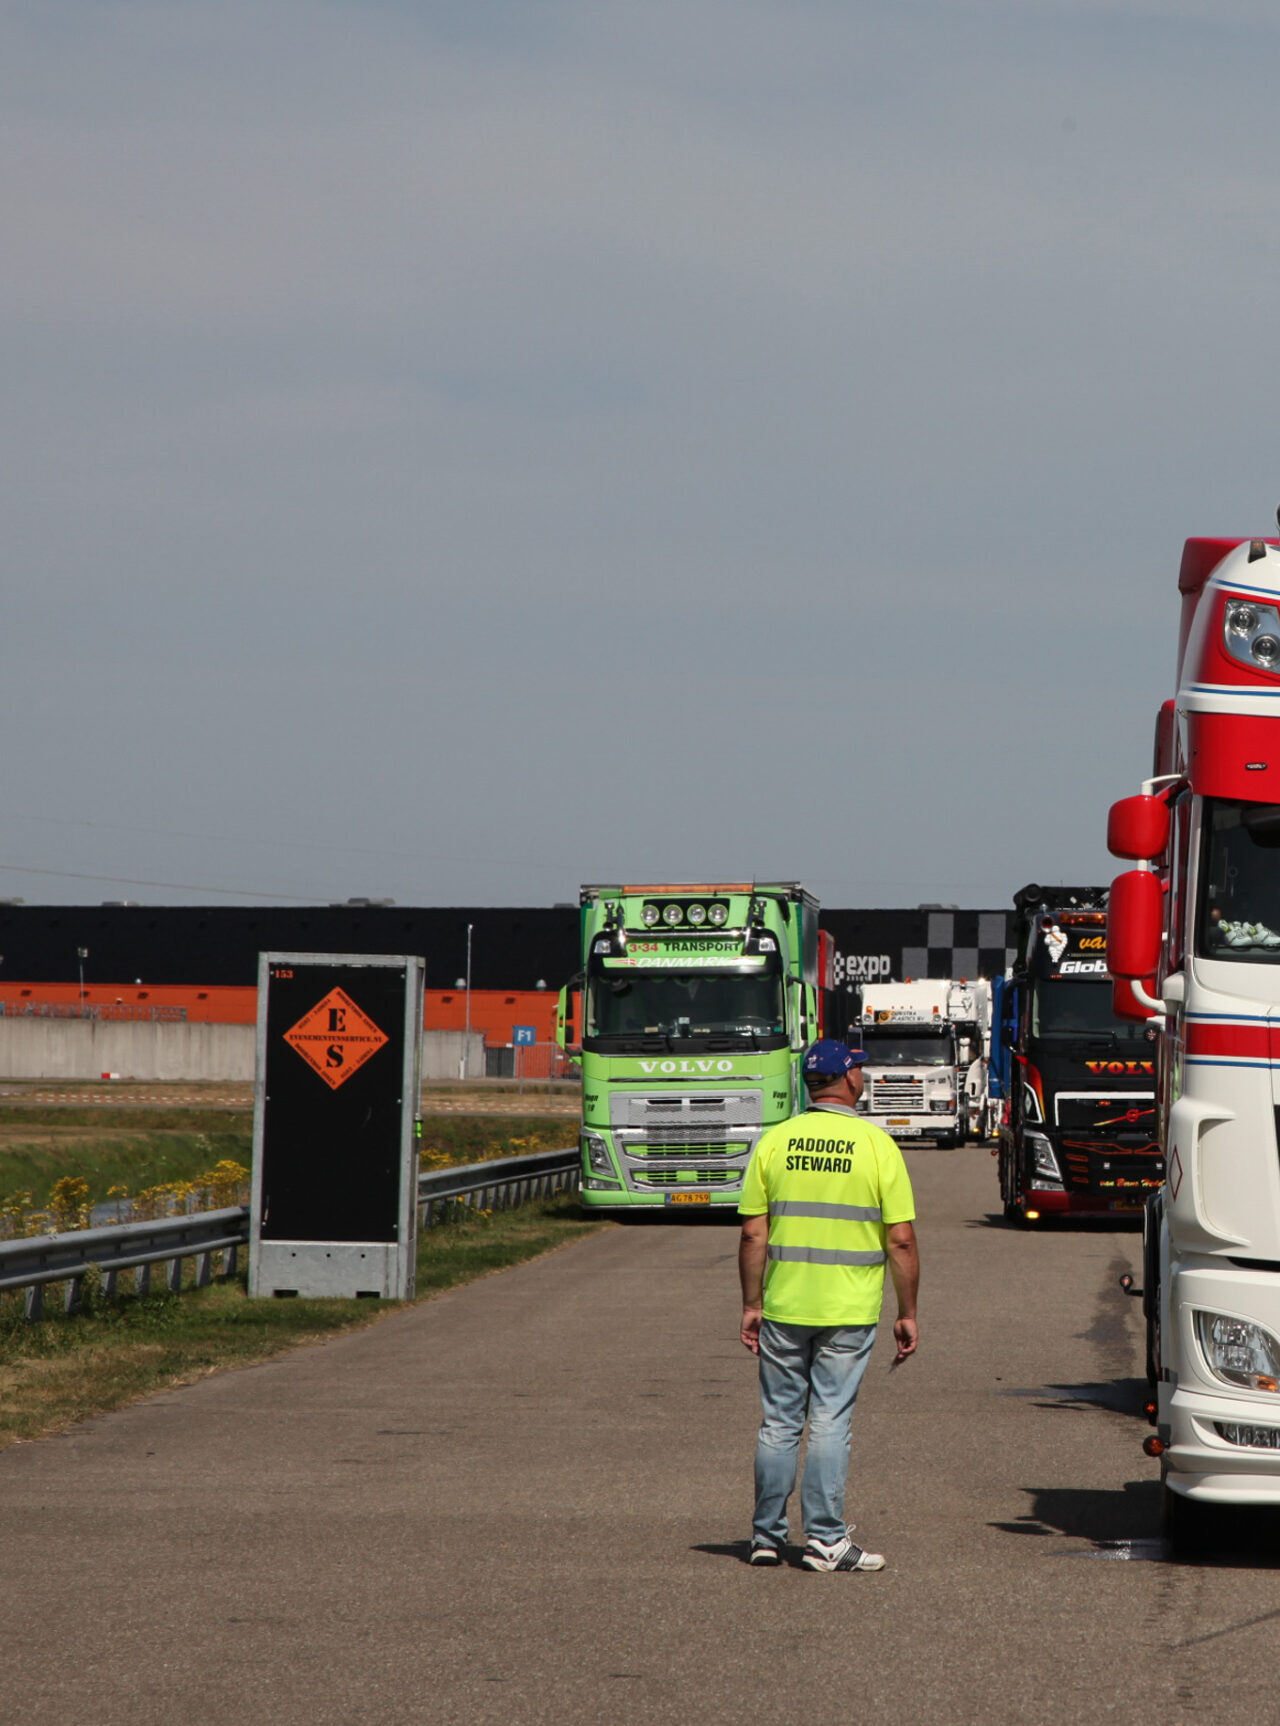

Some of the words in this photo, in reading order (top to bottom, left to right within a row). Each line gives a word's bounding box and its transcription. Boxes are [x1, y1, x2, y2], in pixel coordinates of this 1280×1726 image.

[664, 942, 740, 952] TRANSPORT
[636, 957, 729, 968] DANMARK
[846, 955, 890, 981] expo
[1060, 960, 1108, 974] Glob
[275, 970, 293, 979] 153
[328, 1008, 346, 1032] E
[517, 1030, 531, 1041] F1
[326, 1044, 344, 1068] S
[638, 1060, 733, 1073] VOLVO
[1085, 1061, 1155, 1075] VOLV
[788, 1138, 855, 1155] PADDOCK
[786, 1155, 852, 1173] STEWARD
